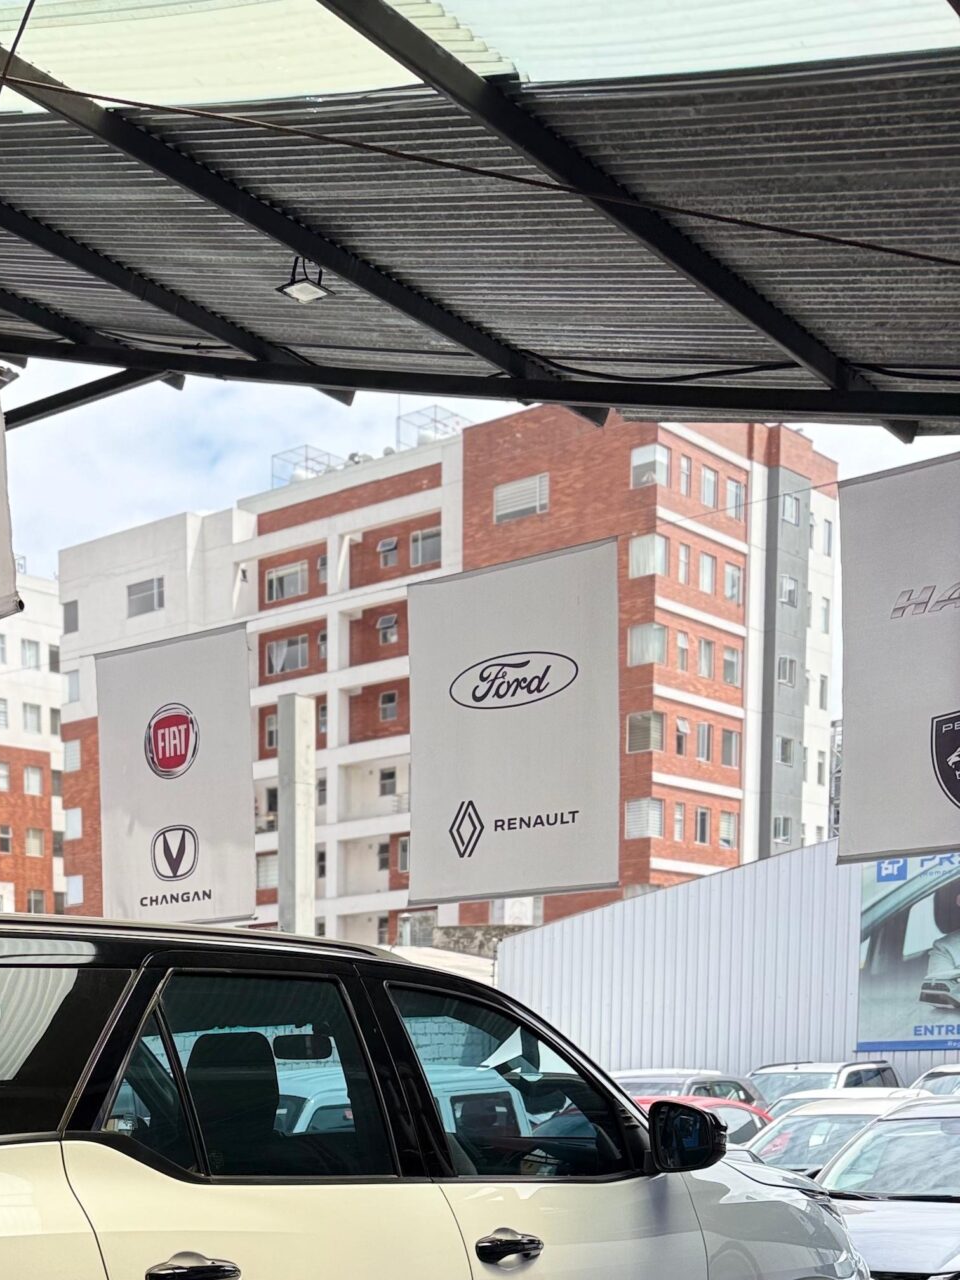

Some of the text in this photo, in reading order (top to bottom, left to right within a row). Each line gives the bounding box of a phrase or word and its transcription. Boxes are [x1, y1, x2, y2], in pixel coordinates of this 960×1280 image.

[472, 659, 552, 702] Ford
[157, 724, 187, 759] FIAT
[494, 810, 580, 831] RENAULT
[140, 889, 212, 907] CHANGAN
